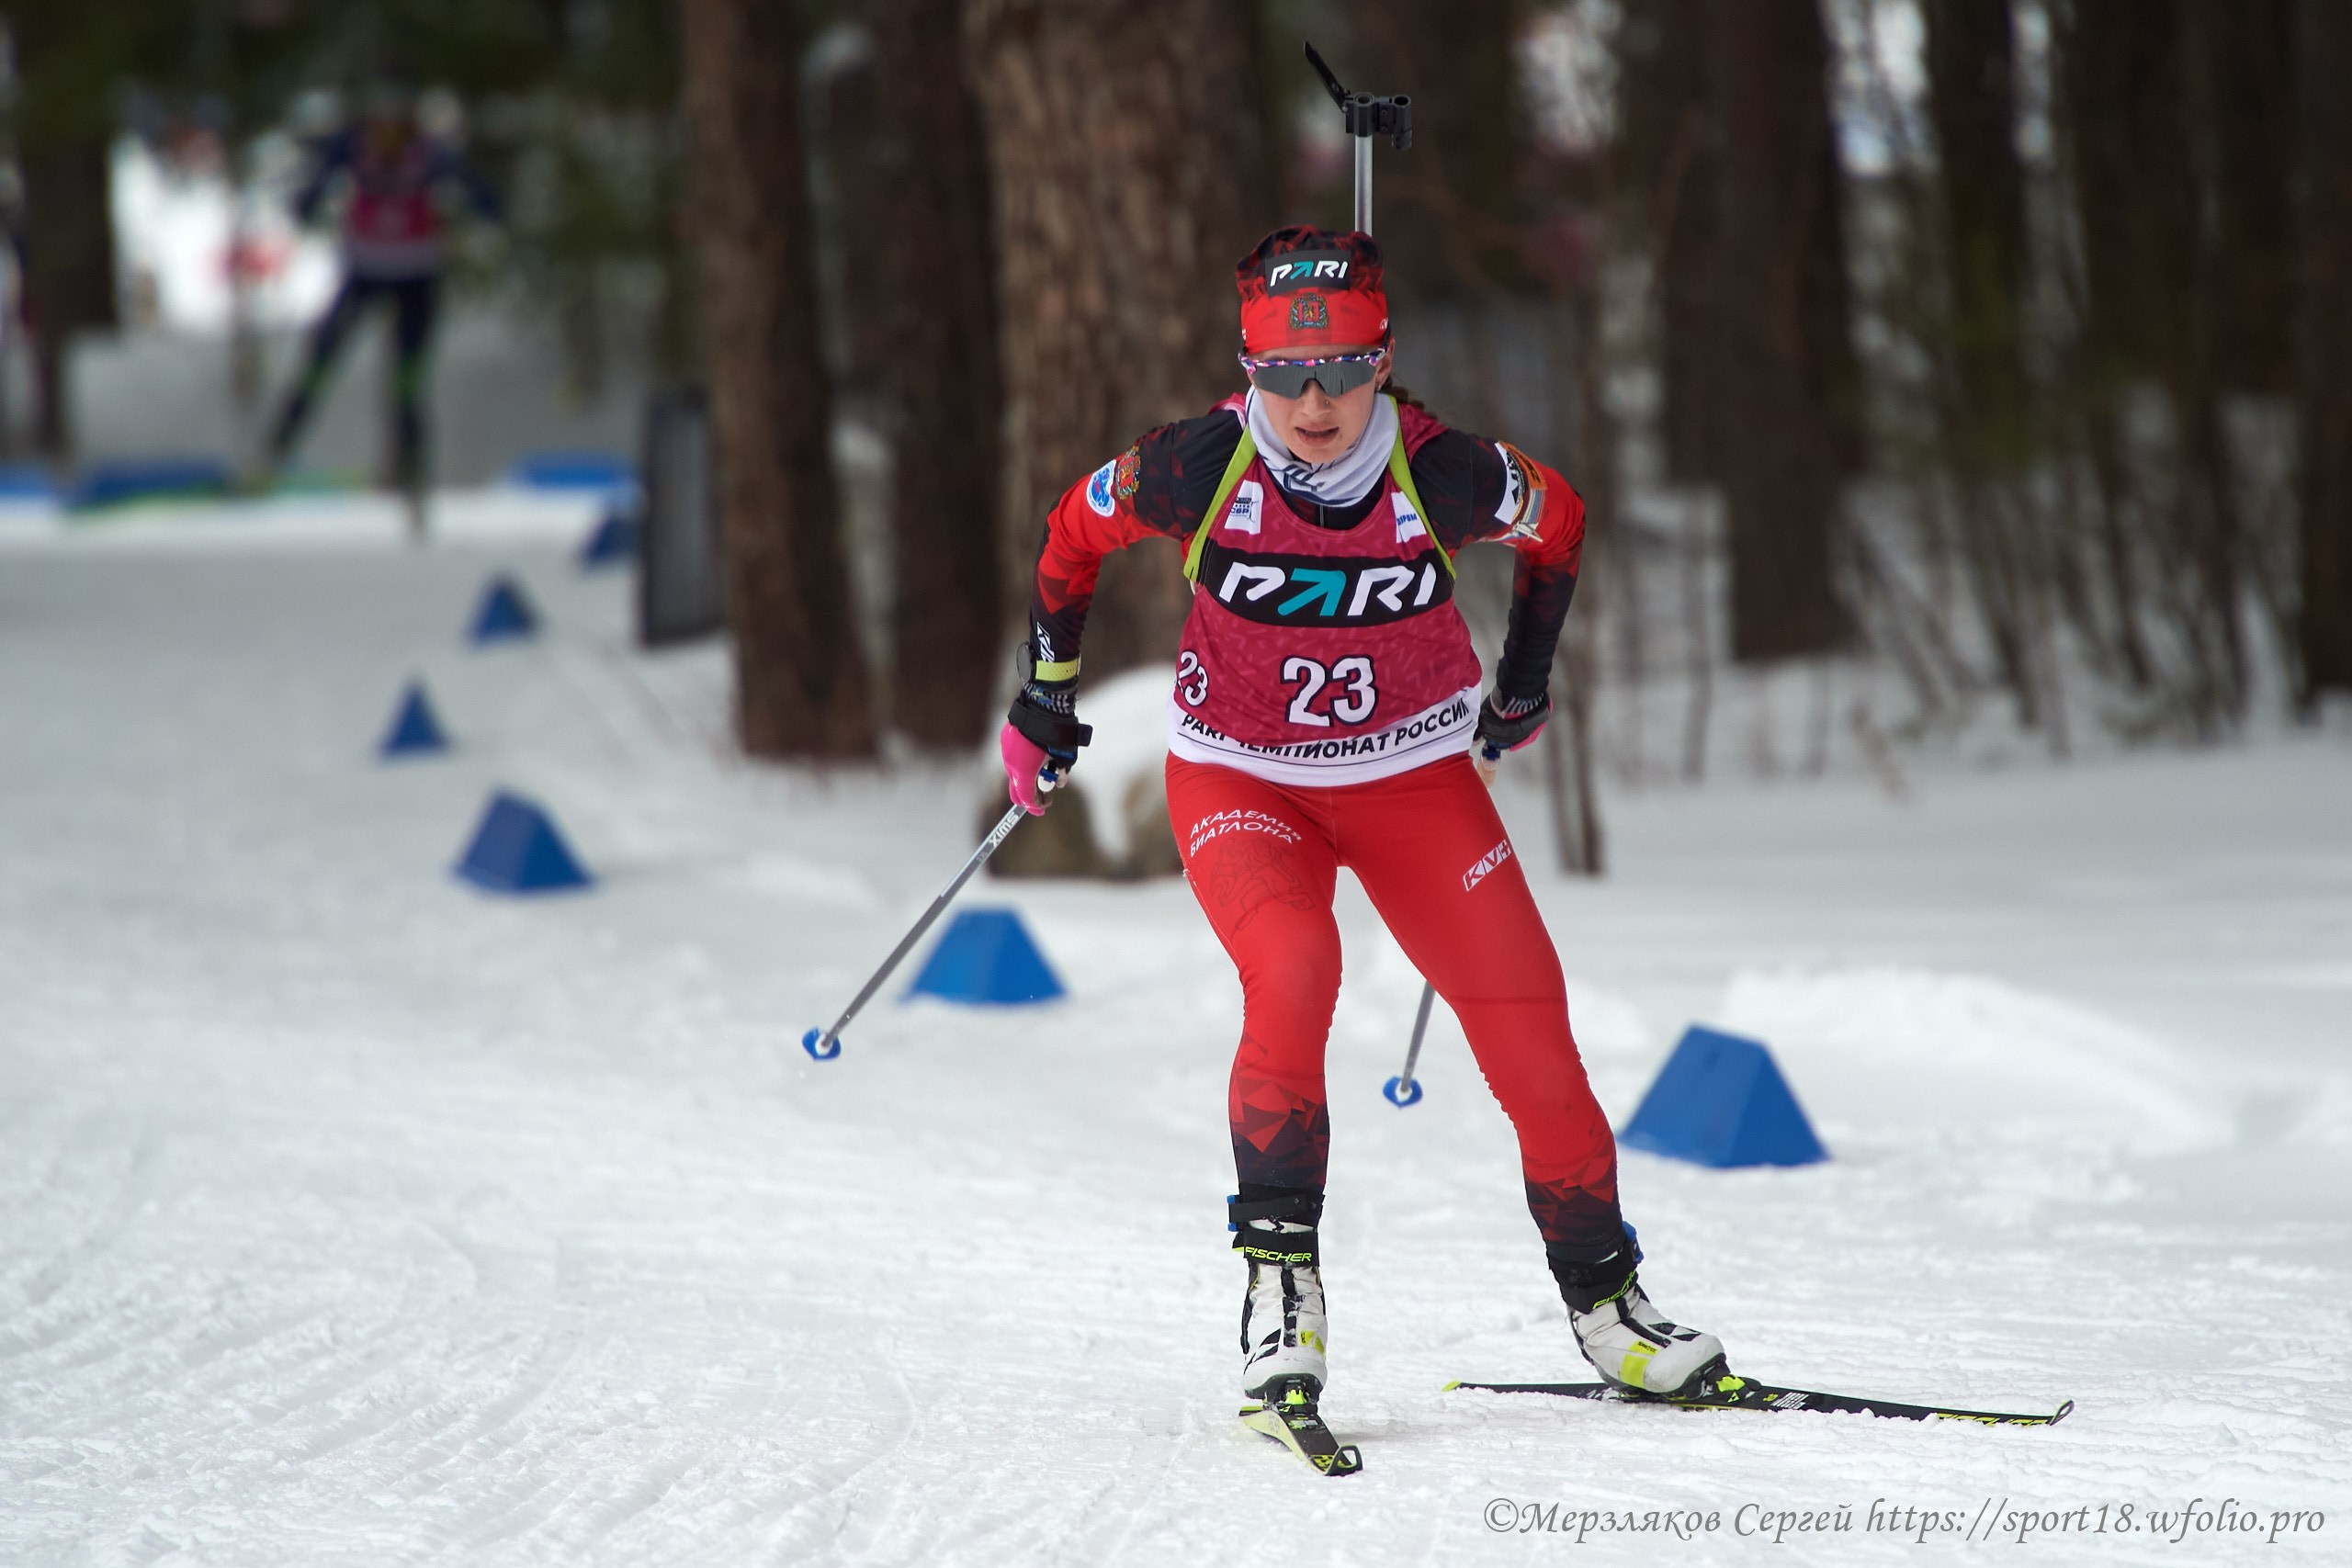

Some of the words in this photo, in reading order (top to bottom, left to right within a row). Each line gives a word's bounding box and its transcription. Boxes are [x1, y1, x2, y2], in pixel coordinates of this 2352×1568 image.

[1270, 260, 1349, 288] PARI
[1218, 561, 1437, 617] PARI
[1177, 649, 1209, 706] 23
[1280, 654, 1379, 728] 23
[1239, 732, 1391, 760] ЕМПИОНАТ
[1190, 809, 1302, 840] АКАДЕМИЯ
[1190, 821, 1292, 858] БИАТЛОНА
[1245, 1246, 1312, 1262] FISCHER
